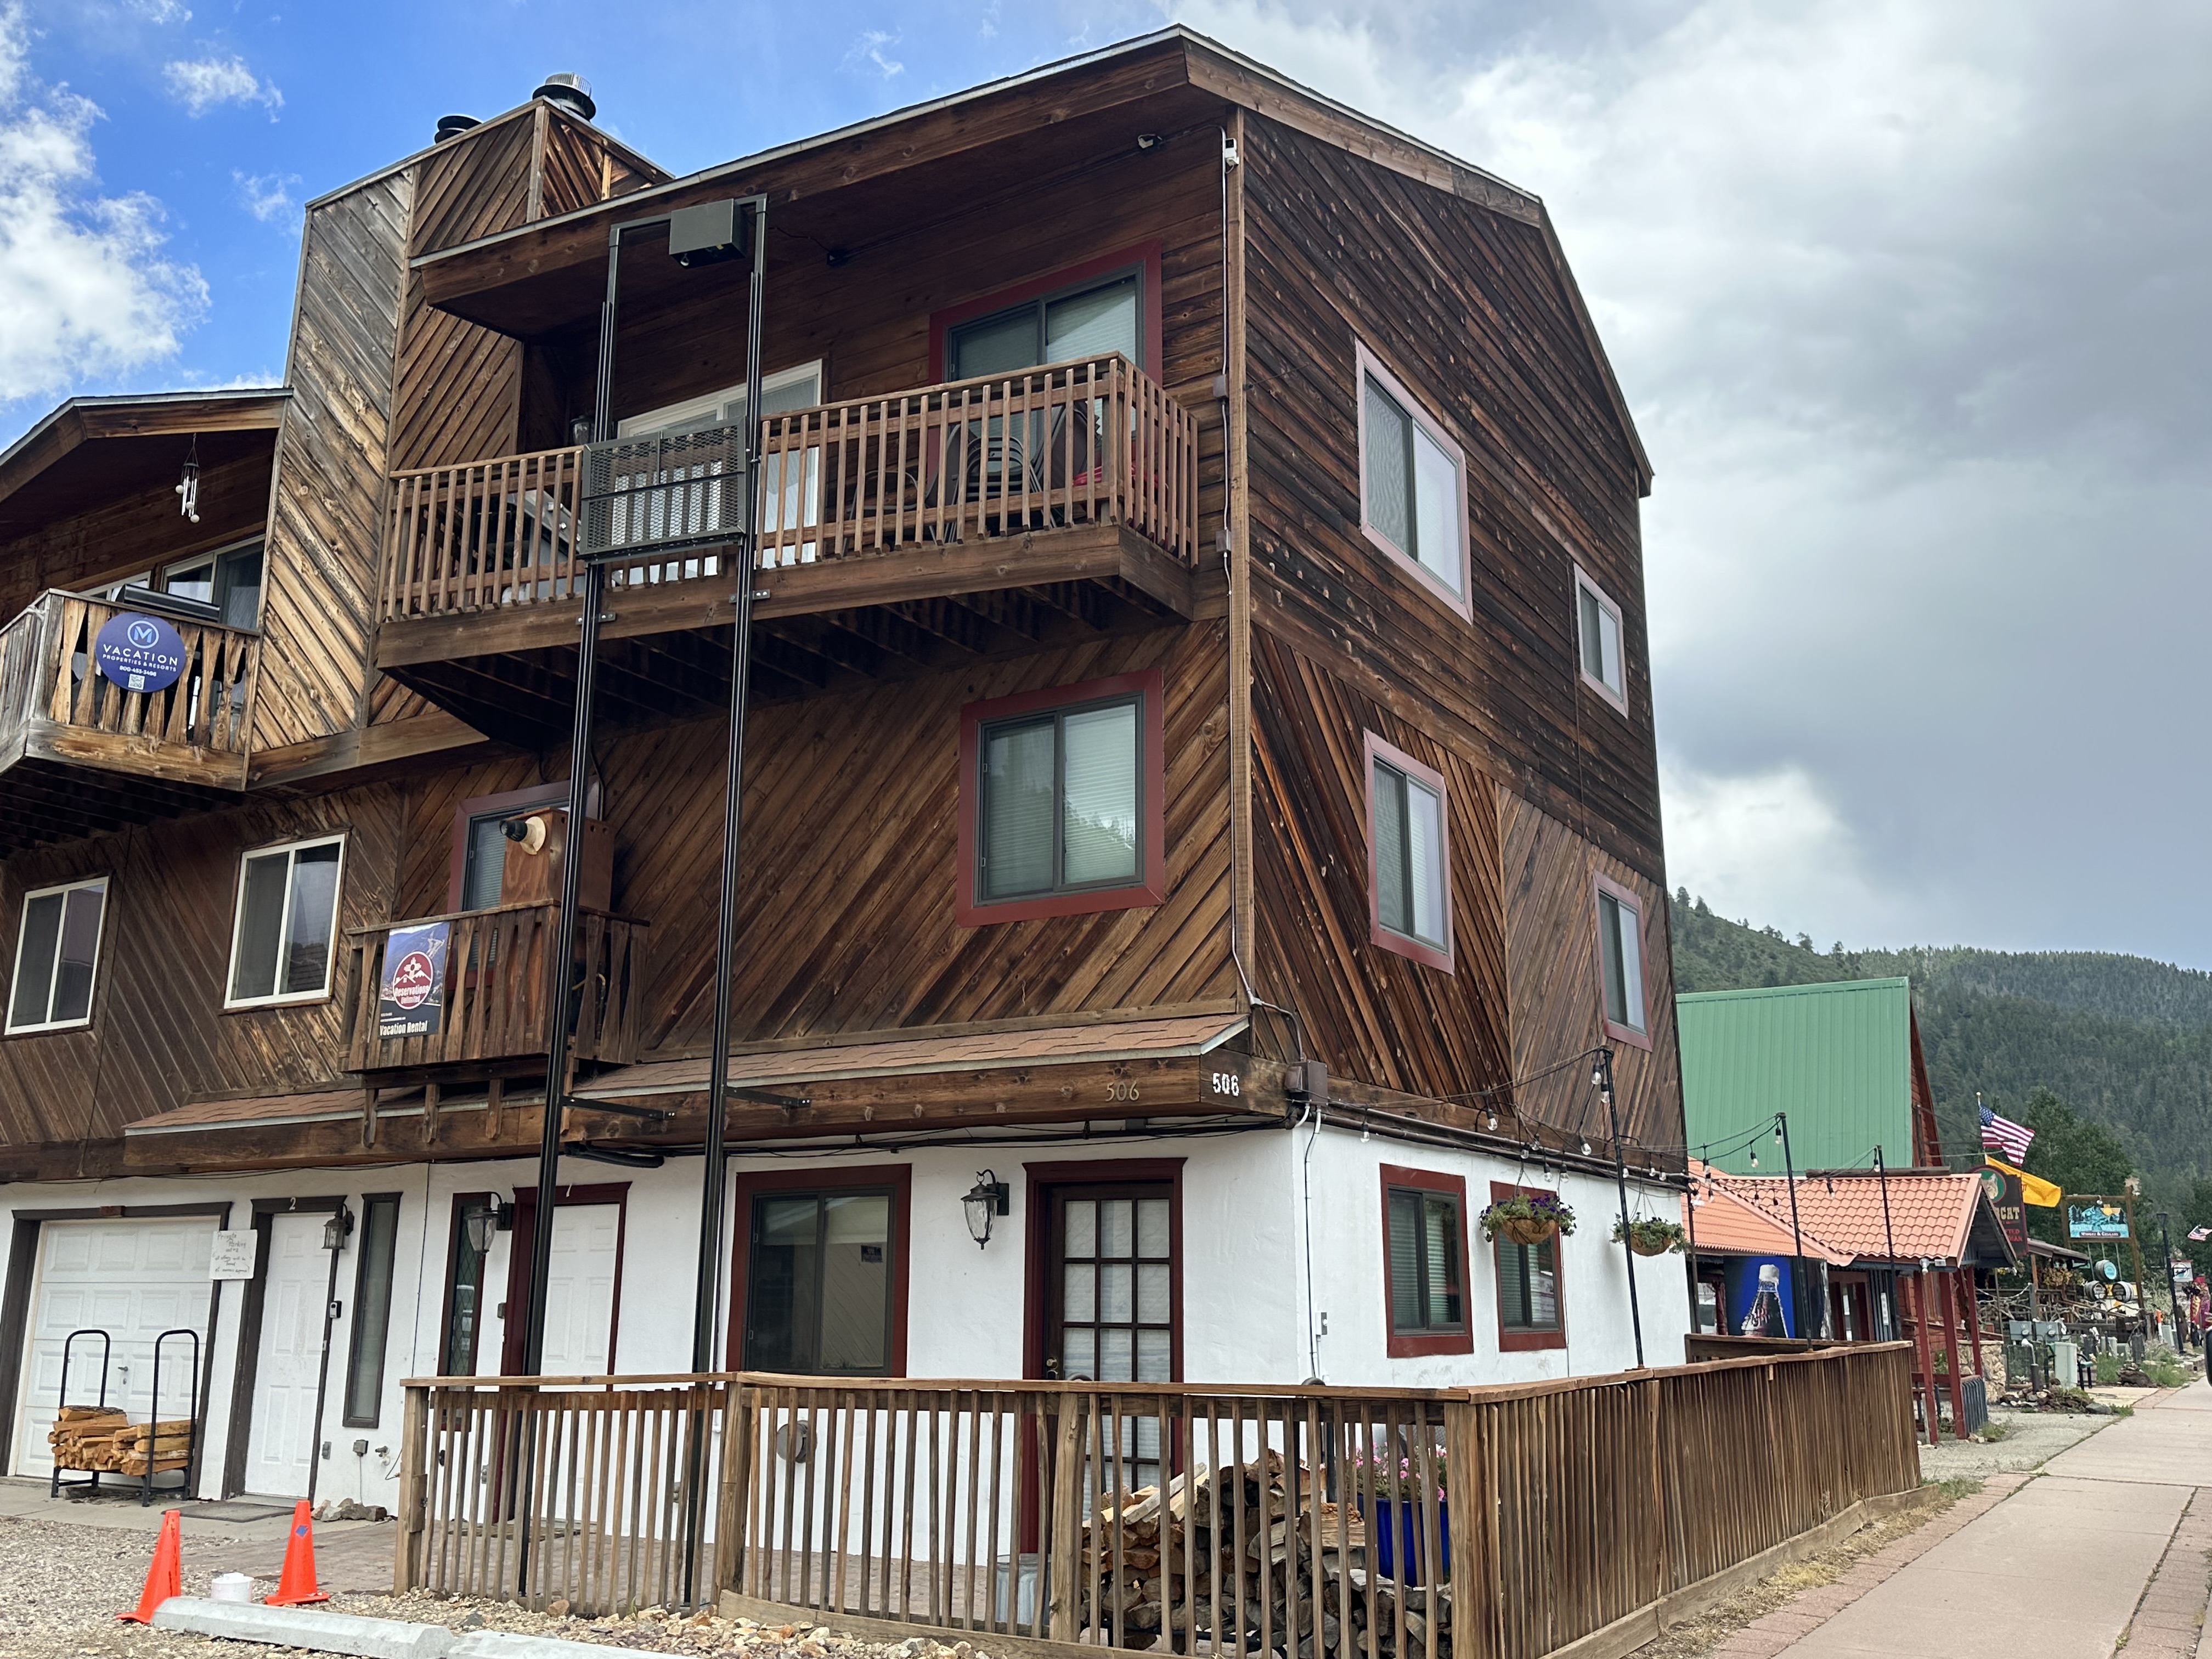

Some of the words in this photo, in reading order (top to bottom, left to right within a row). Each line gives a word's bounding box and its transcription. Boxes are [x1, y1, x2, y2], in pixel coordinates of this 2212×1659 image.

[103, 644, 178, 666] VACATION
[103, 654, 142, 665] PROPERTIES
[149, 662, 176, 672] RESORTS
[395, 984, 429, 997] Reservations
[380, 1022, 406, 1036] Vacation
[407, 1020, 428, 1033] Rental
[1105, 1080, 1139, 1102] 506
[1212, 1073, 1239, 1097] 506
[289, 1197, 296, 1210] 2
